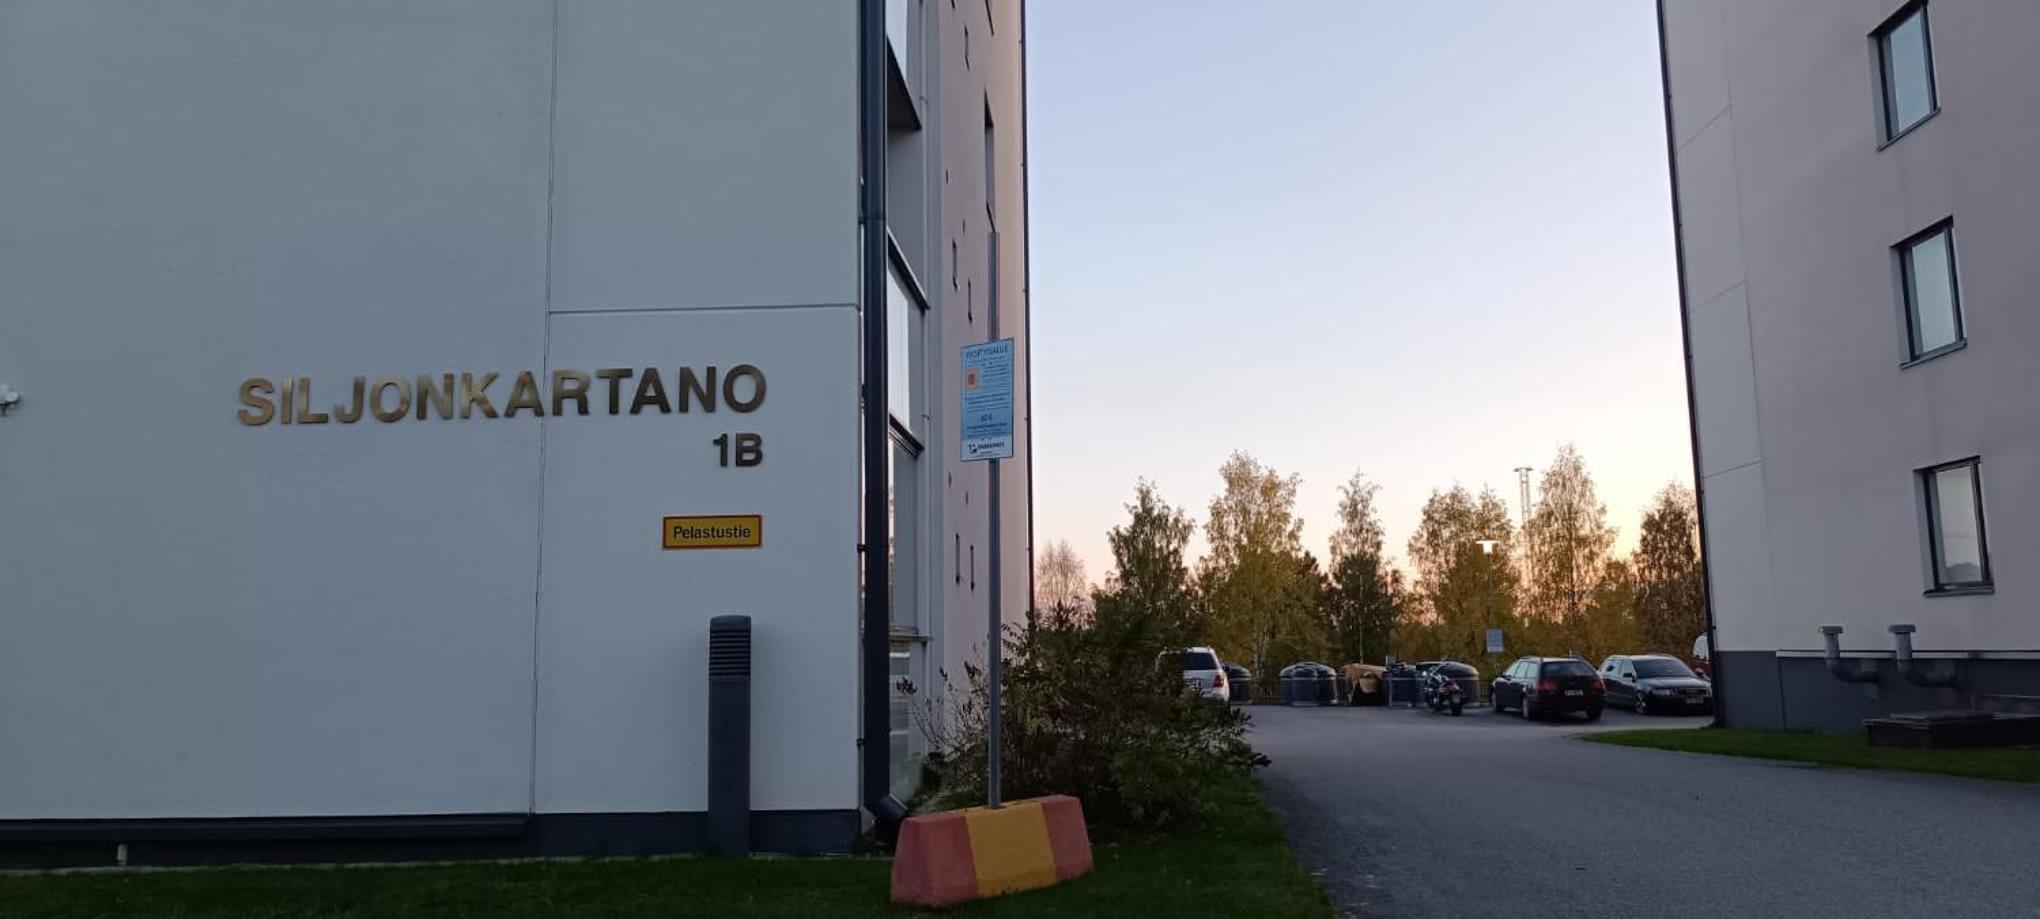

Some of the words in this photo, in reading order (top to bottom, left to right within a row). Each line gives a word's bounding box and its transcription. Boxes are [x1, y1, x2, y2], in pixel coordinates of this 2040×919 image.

[237, 364, 767, 426] SILJONKARTANO
[713, 433, 763, 468] 1B
[672, 525, 751, 539] Pelastustie
